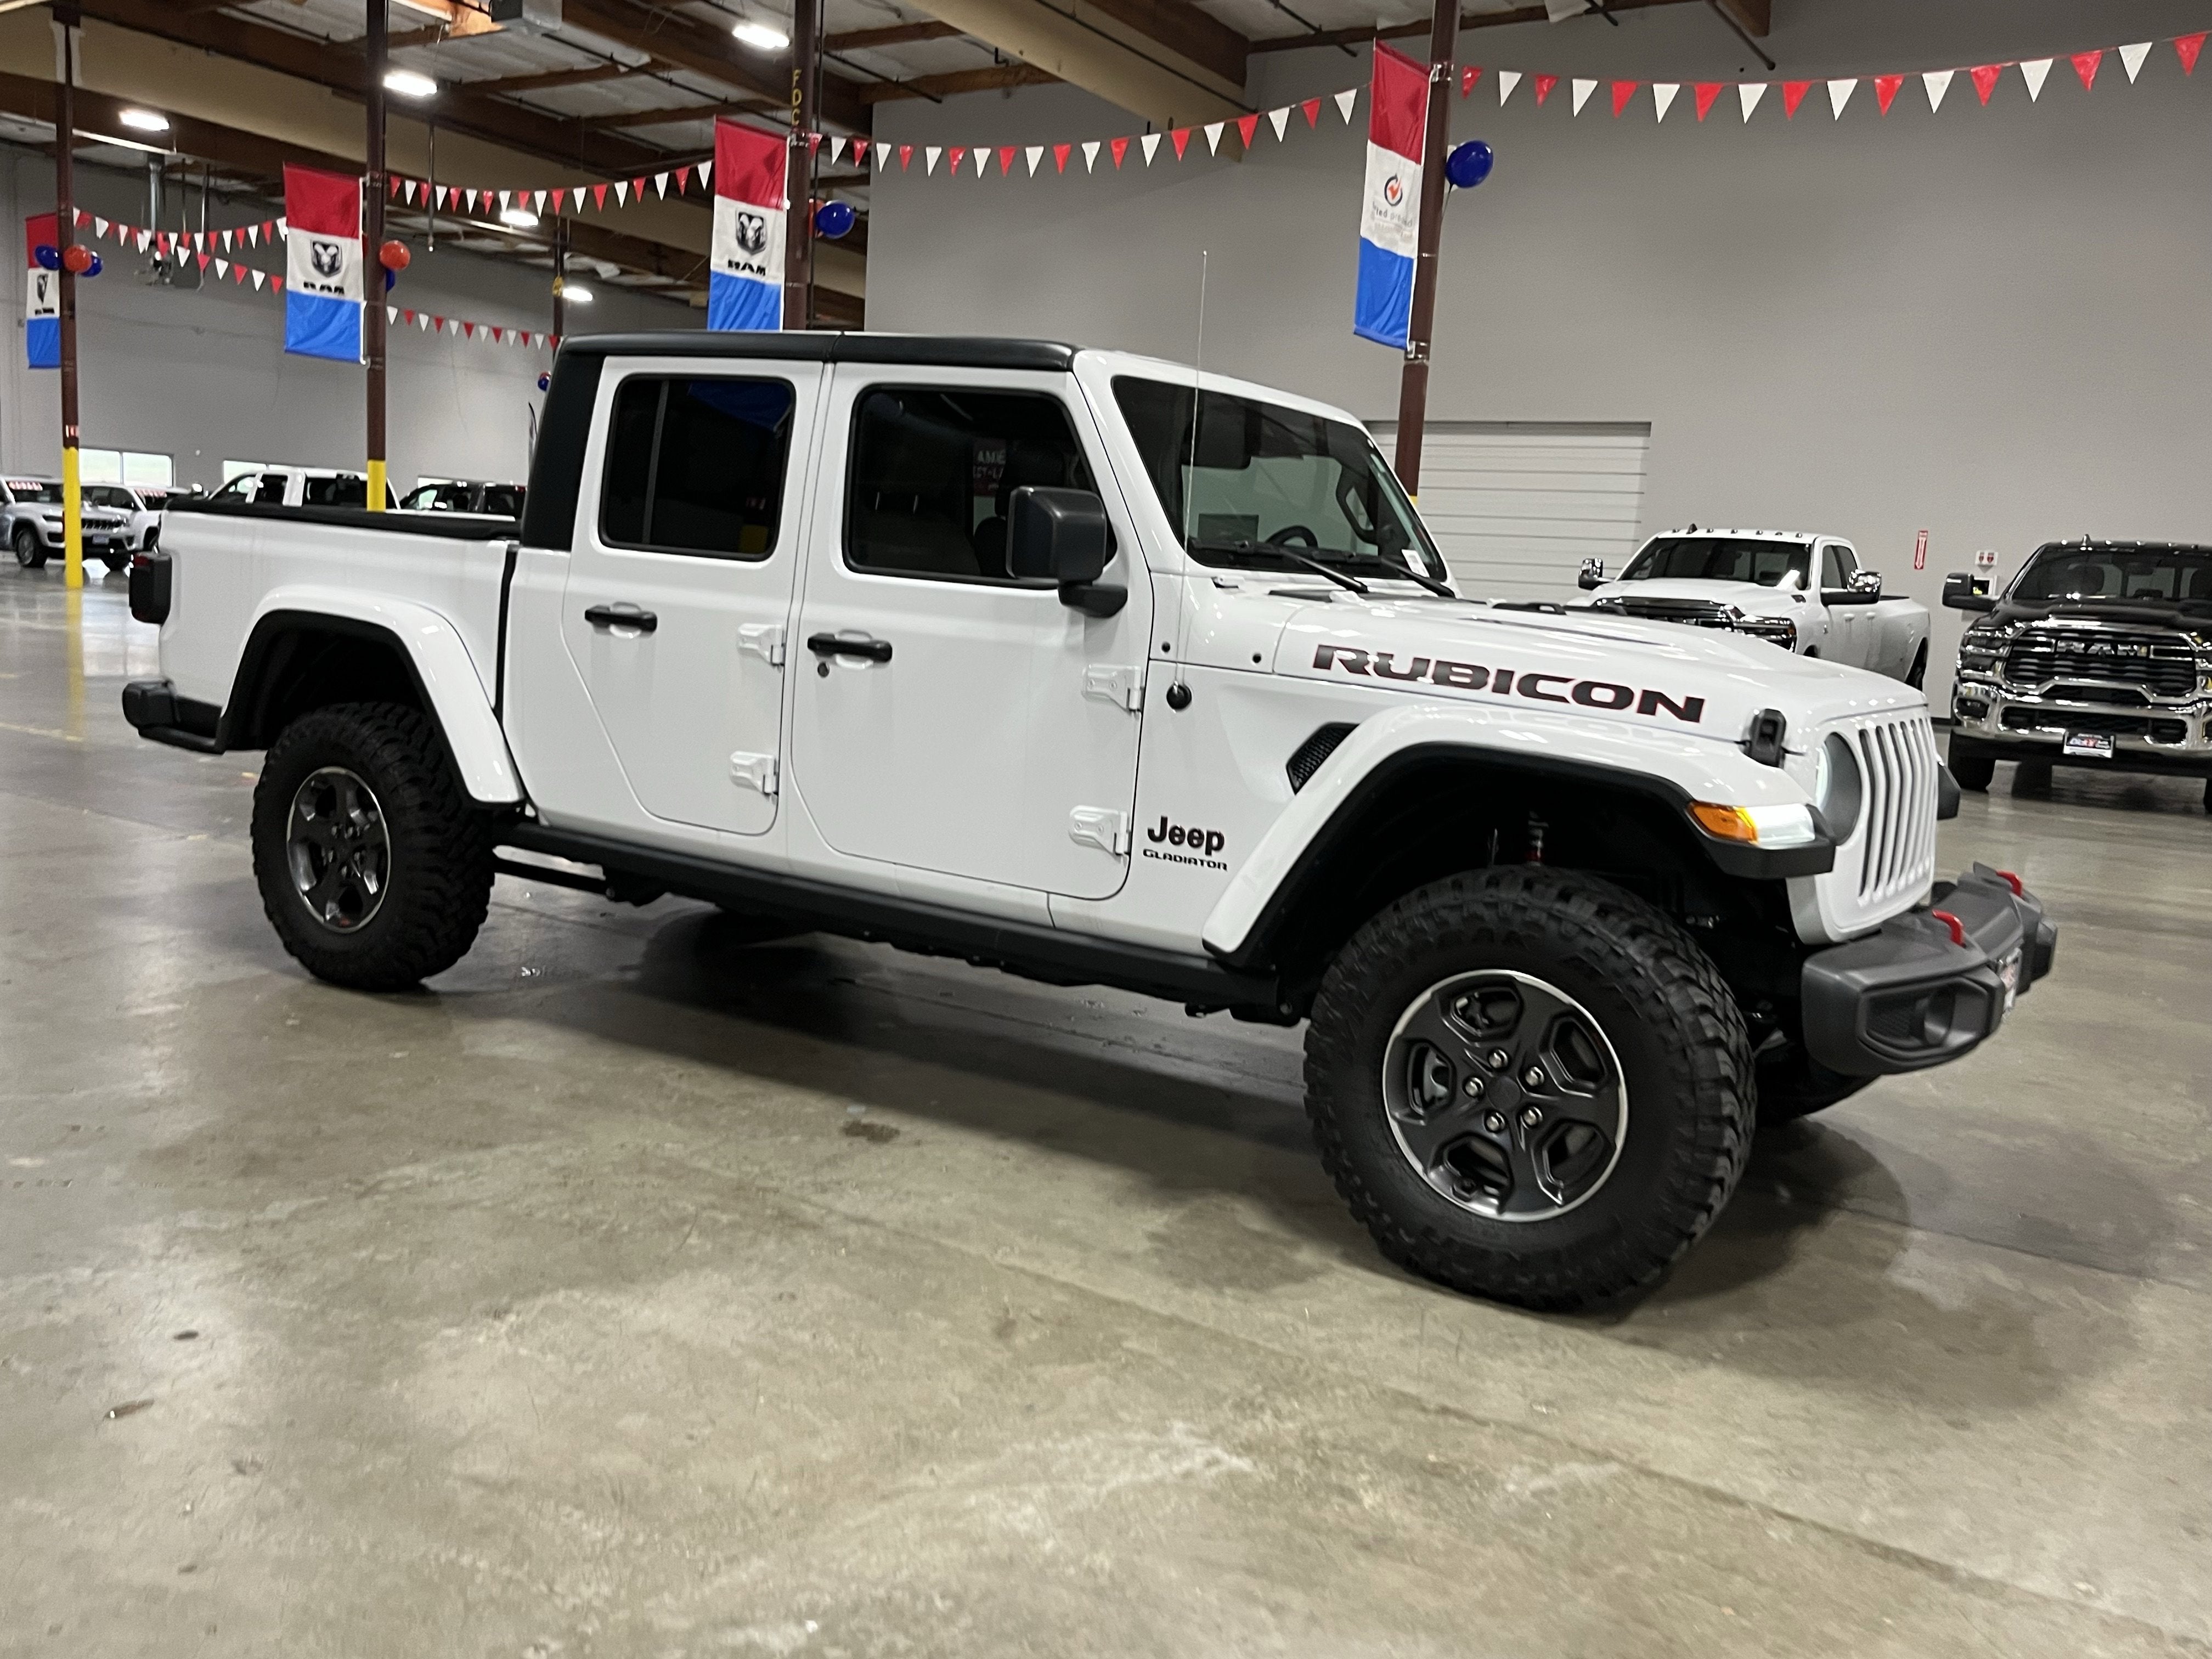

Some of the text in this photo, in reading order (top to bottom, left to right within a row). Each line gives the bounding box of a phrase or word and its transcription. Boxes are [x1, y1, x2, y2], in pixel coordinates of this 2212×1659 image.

[2057, 640, 2147, 657] RAM
[1312, 644, 1706, 723] RUBICON
[1147, 815, 1225, 857] Jeep
[1143, 848, 1228, 872] GLADIATOR
